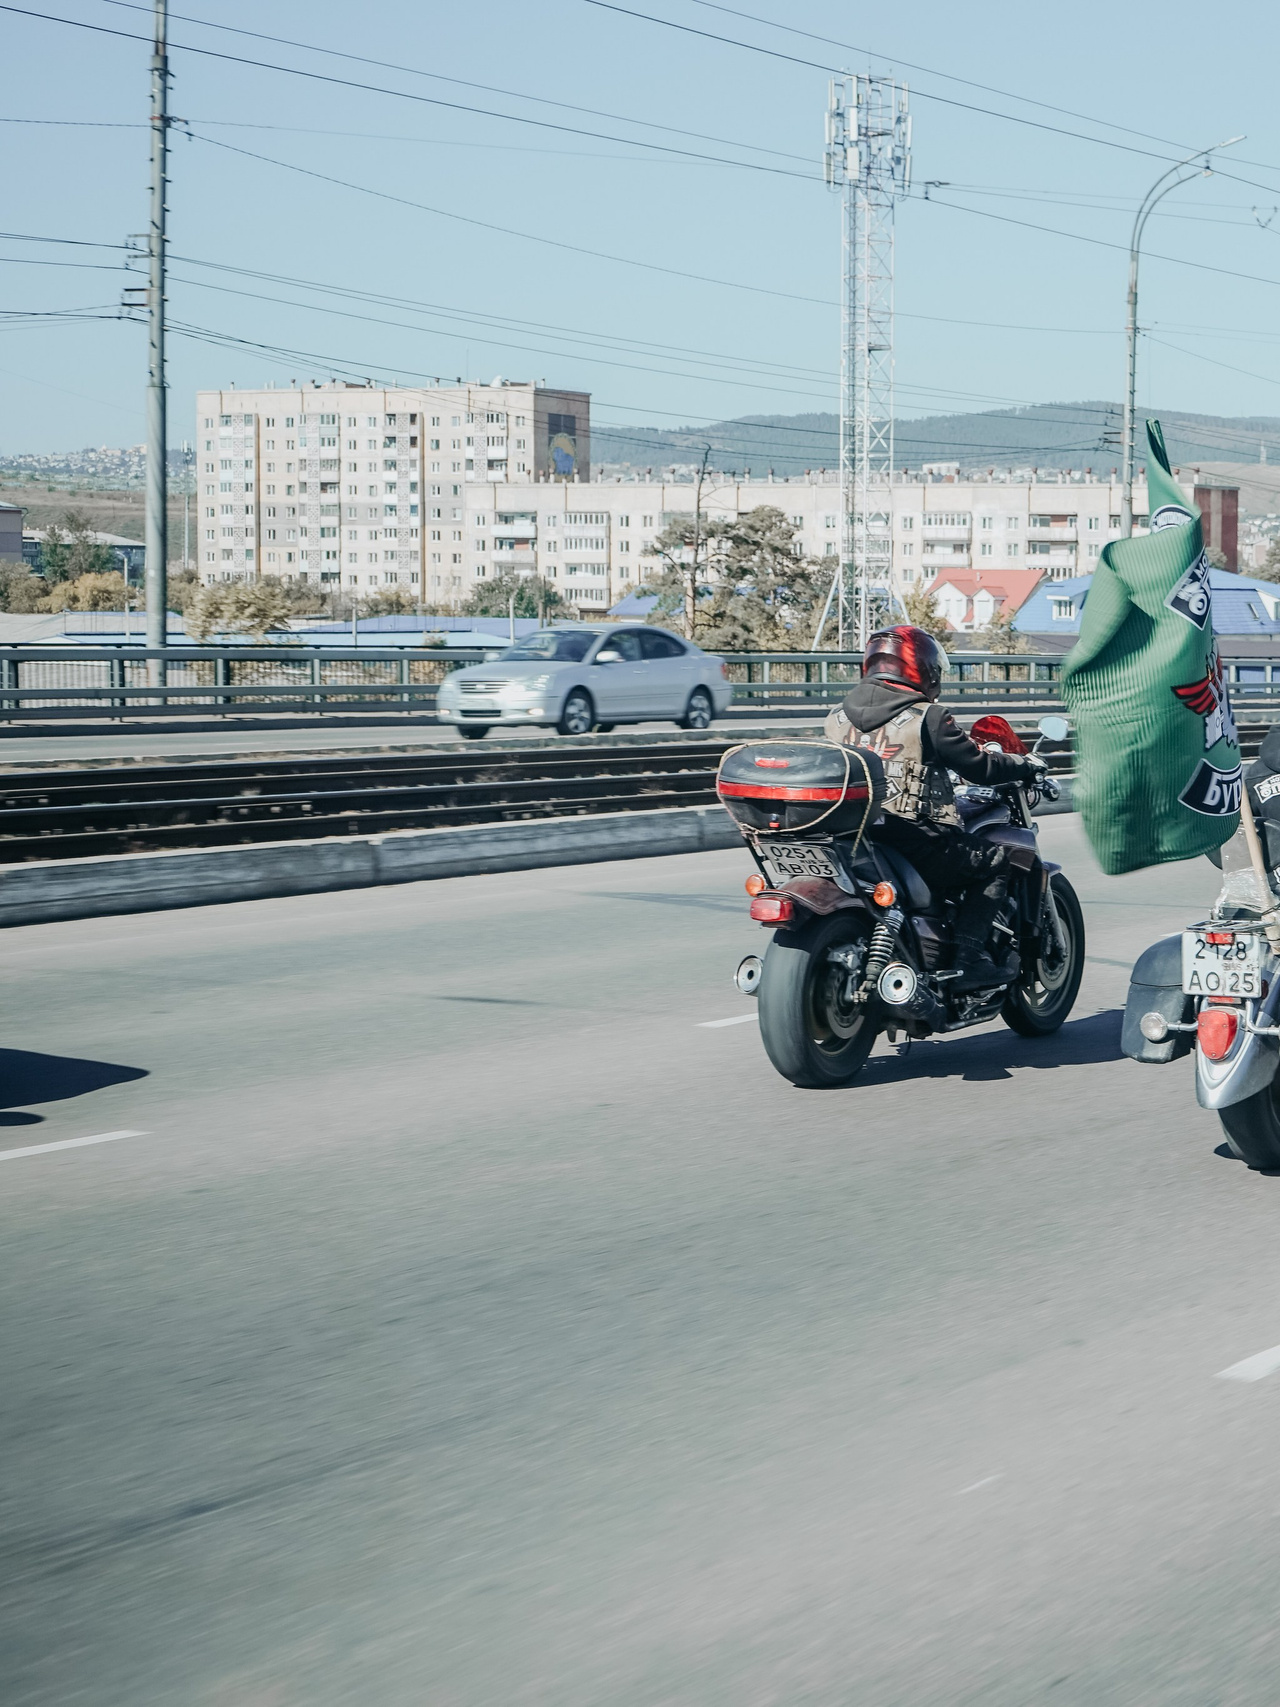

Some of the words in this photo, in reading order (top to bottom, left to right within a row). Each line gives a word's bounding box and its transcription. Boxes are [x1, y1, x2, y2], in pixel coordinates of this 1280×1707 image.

[770, 846, 818, 860] 0251
[808, 865, 833, 876] 03
[1195, 939, 1247, 961] 2128
[1229, 973, 1254, 993] 25
